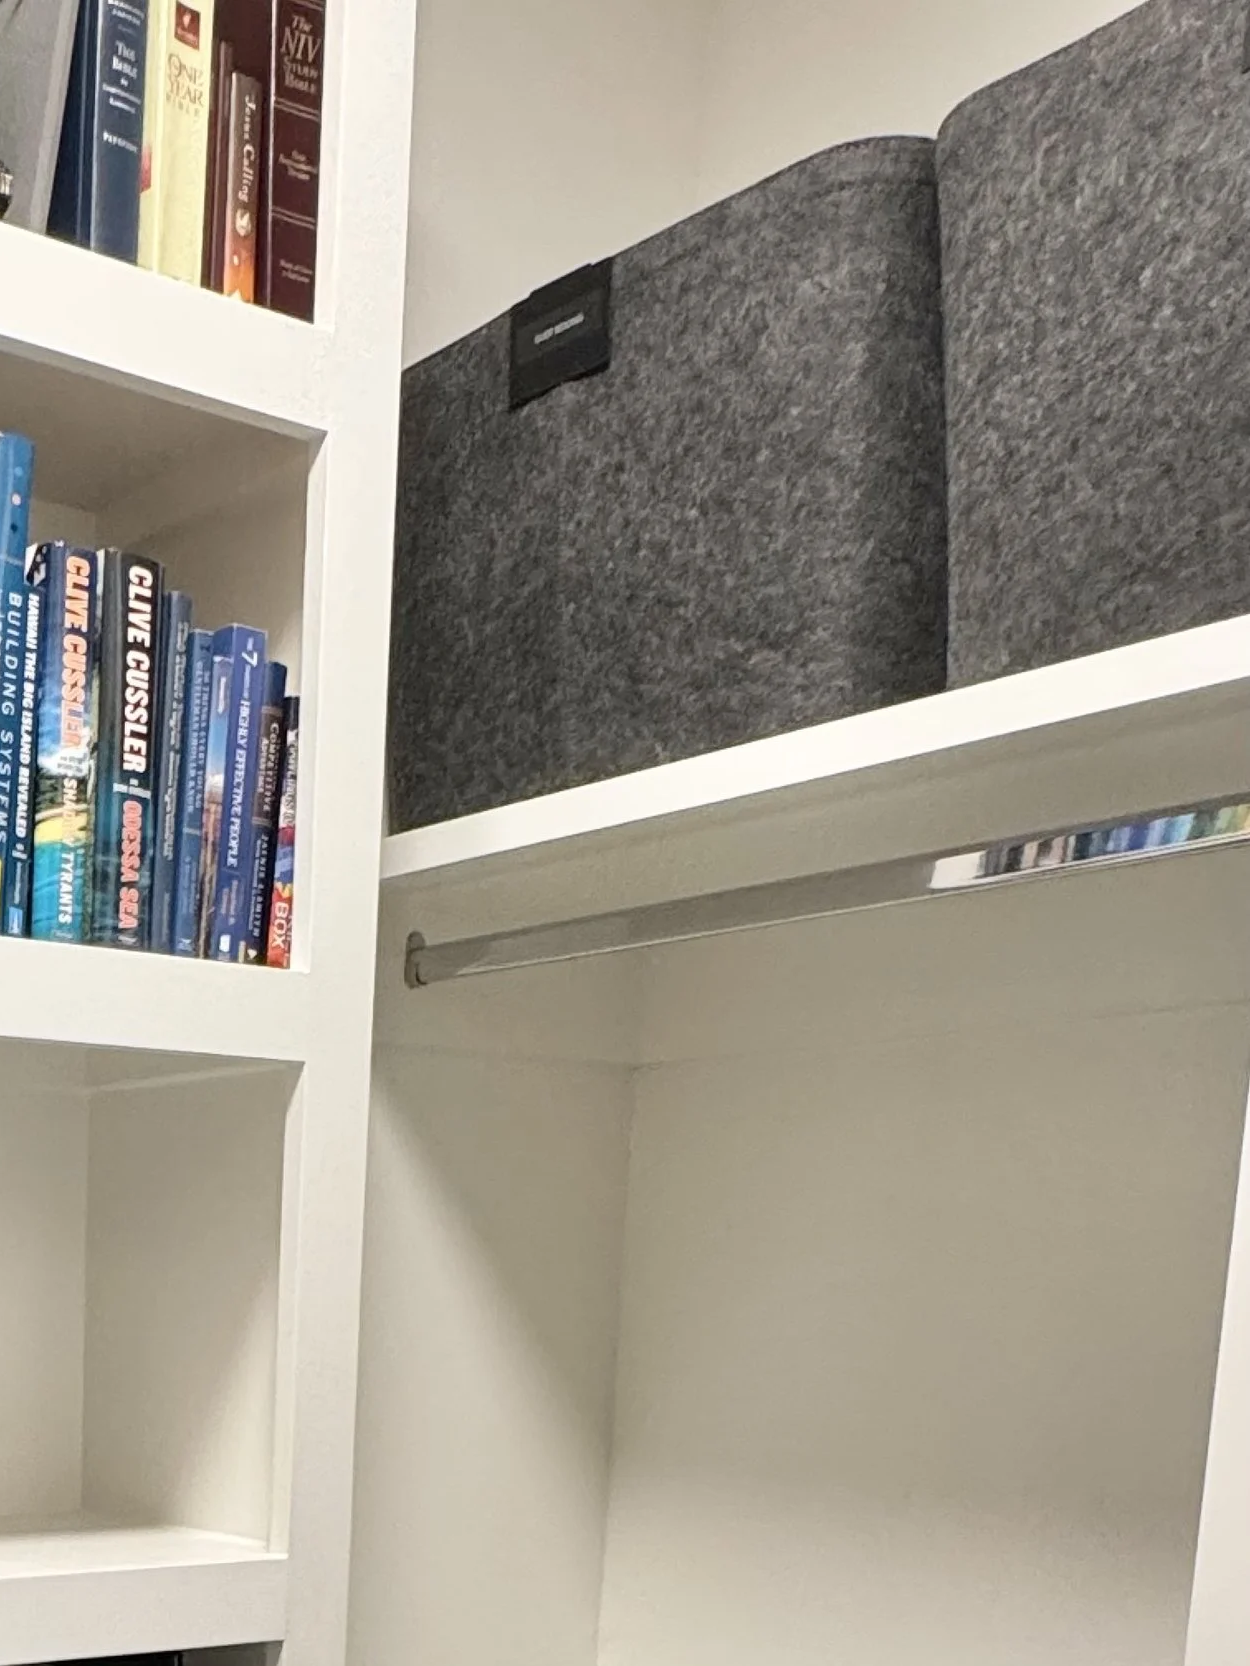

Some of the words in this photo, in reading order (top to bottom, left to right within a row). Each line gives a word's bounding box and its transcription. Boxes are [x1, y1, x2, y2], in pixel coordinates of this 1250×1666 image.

[280, 25, 322, 64] NIV
[291, 14, 314, 33] The
[167, 53, 204, 85] ONE
[167, 75, 204, 108] YEAR
[245, 94, 257, 139] Jesus
[238, 144, 255, 203] Calling
[64, 555, 91, 634] CLIVE
[127, 564, 154, 648] CLIVE
[0, 591, 23, 717] BUILDING
[61, 635, 88, 749] CUSSLER
[122, 650, 151, 775] CUSSLER
